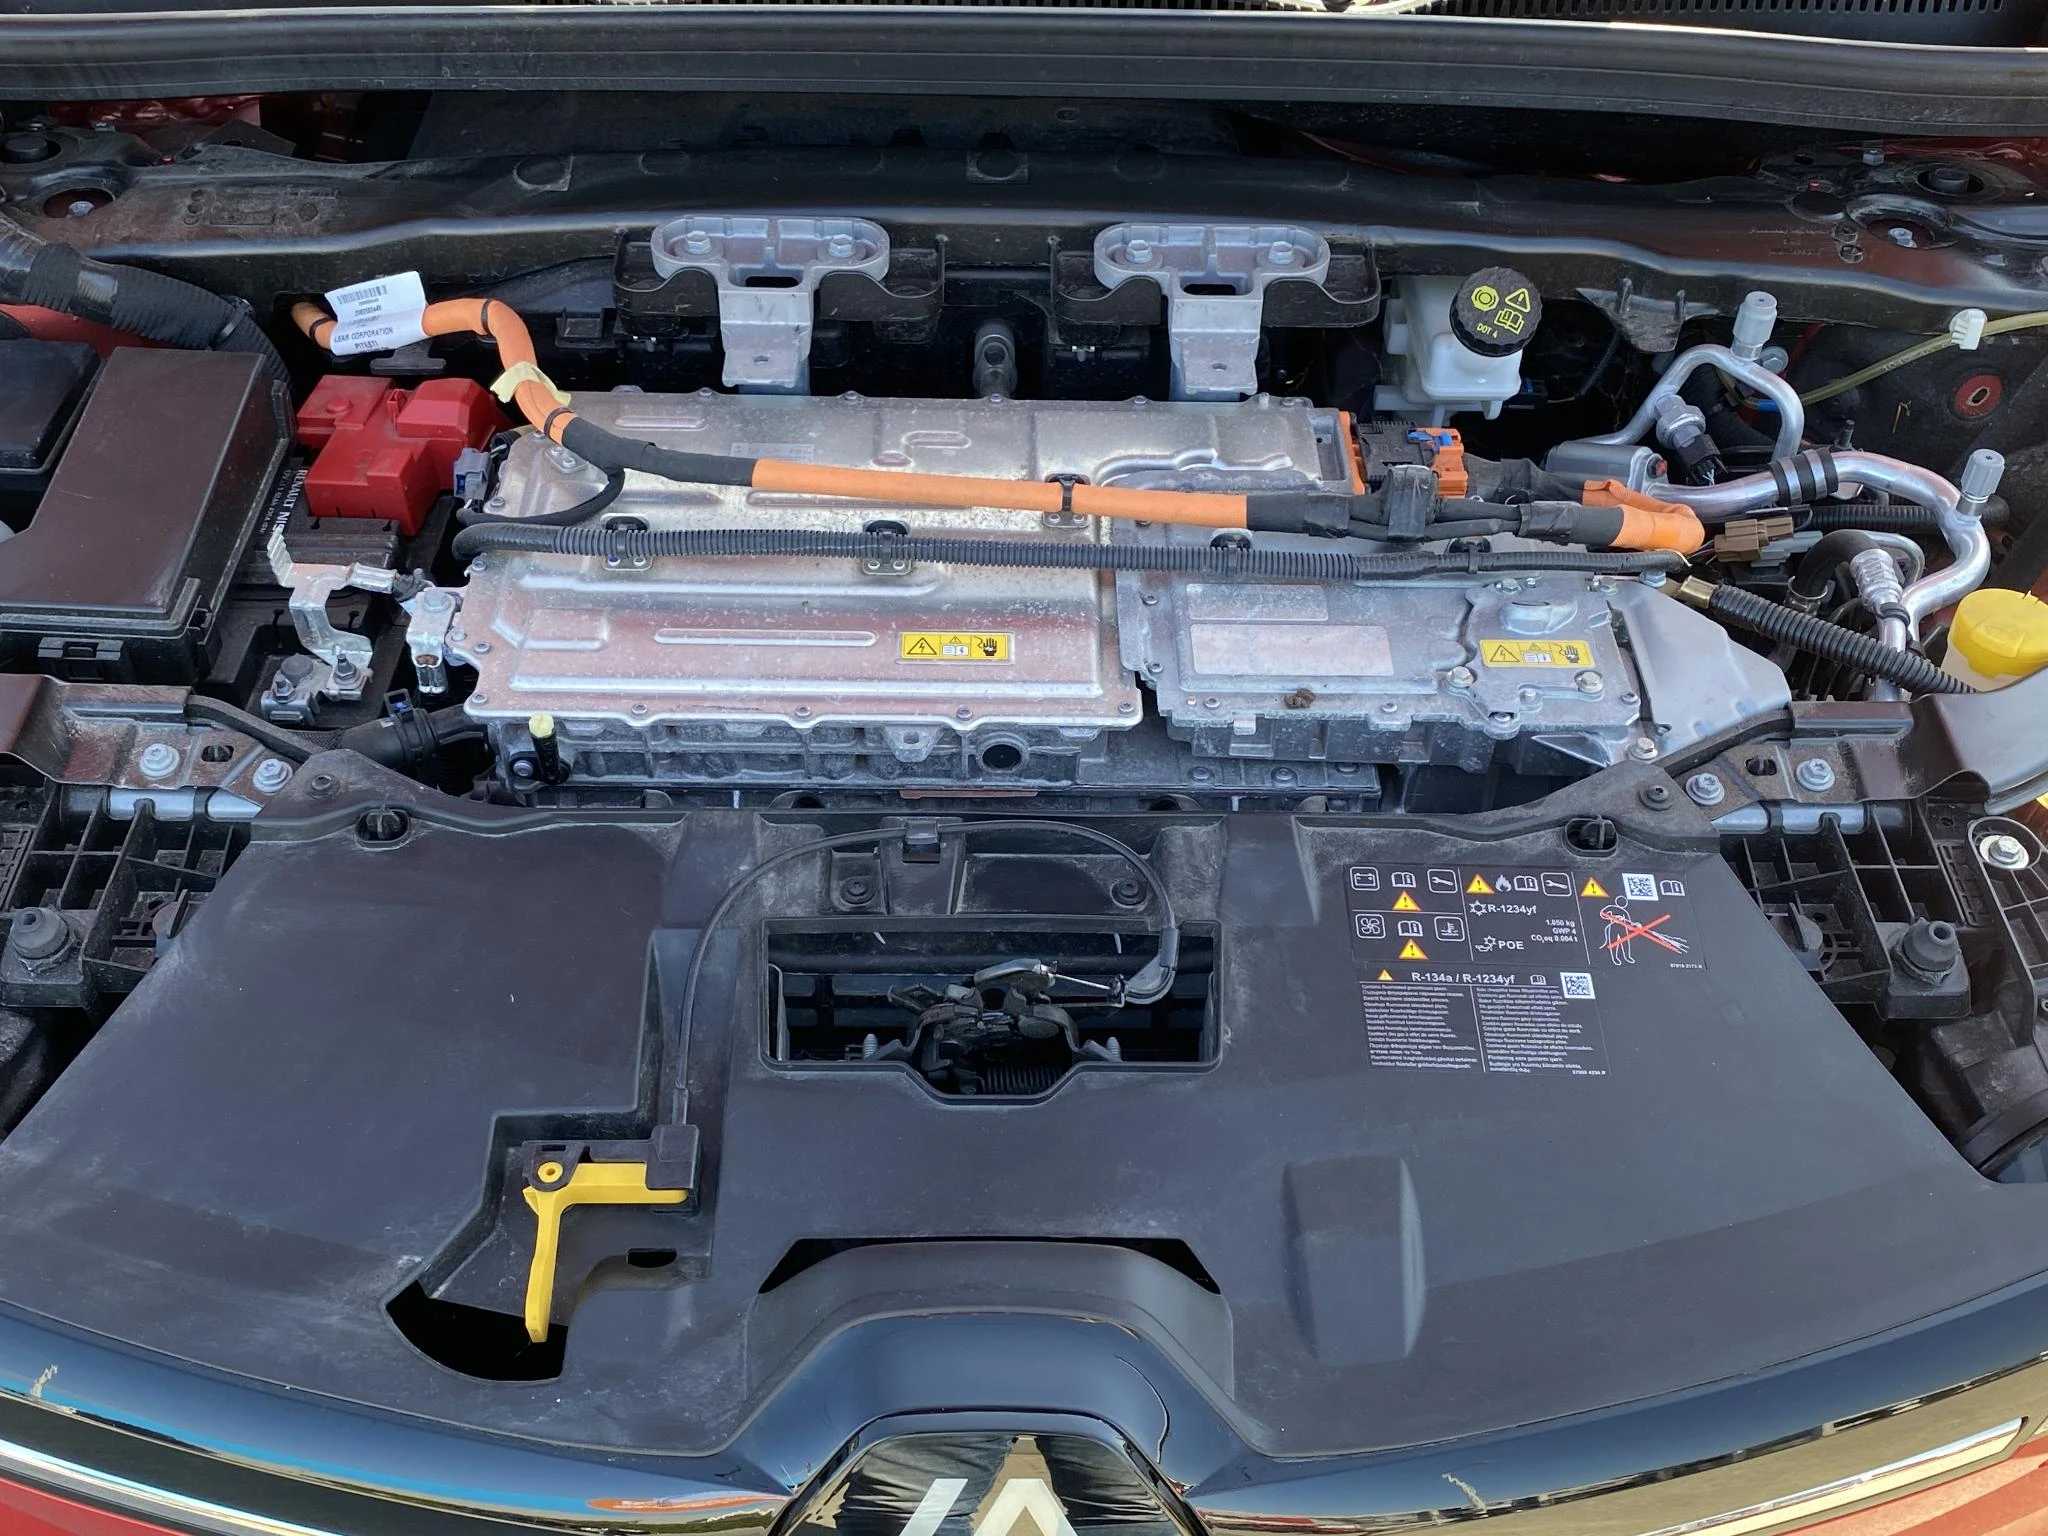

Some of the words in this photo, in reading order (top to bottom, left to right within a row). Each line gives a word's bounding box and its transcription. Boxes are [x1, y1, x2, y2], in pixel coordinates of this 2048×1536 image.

[334, 334, 349, 343] LEAR
[351, 327, 393, 340] CORPORATION
[1477, 323, 1492, 335] DOT
[1493, 330, 1498, 338] 4
[283, 469, 309, 509] RENAULT
[1488, 904, 1537, 915] R-1234yf
[1565, 920, 1575, 928] kg
[1498, 940, 1525, 950] POE
[1411, 972, 1452, 982] R-134a
[1455, 973, 1460, 982] /
[1462, 974, 1516, 985] R-1234yf
